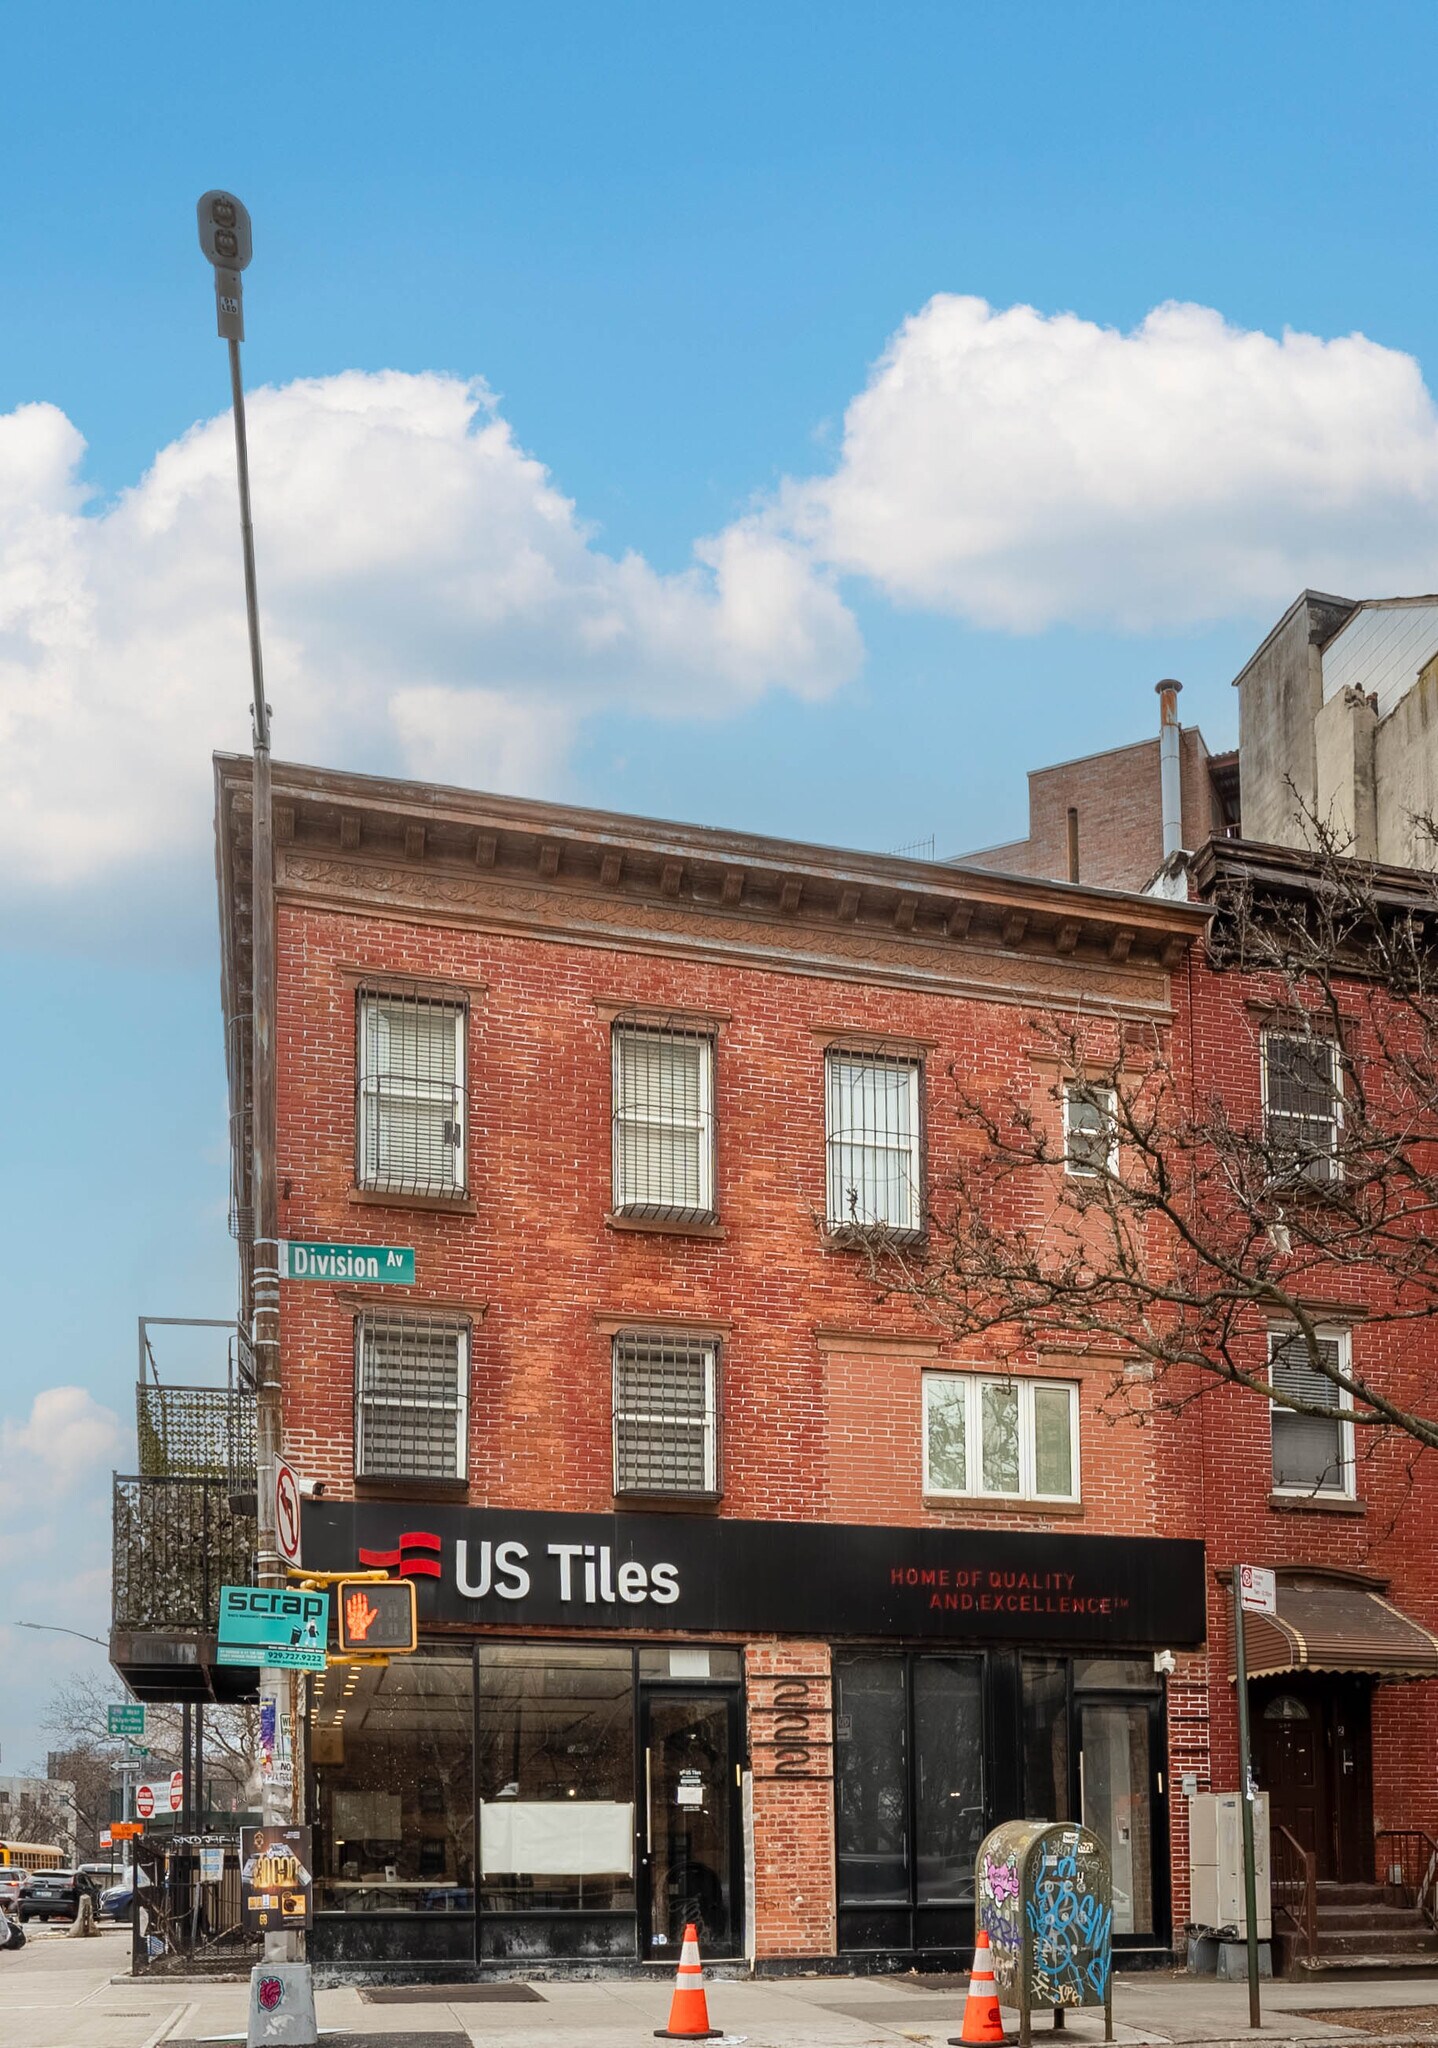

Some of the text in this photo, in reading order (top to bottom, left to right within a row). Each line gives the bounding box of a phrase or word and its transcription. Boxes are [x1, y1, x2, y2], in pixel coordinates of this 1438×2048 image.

[294, 1247, 403, 1278] Division Av
[456, 1540, 681, 1604] US Tiles
[890, 1568, 1076, 1589] HOME OF QUALITY
[228, 1592, 323, 1622] scrap
[929, 1594, 973, 1610] AND
[978, 1595, 1112, 1614] EXCELLENCE
[268, 1651, 322, 1662] 929.727.9222
